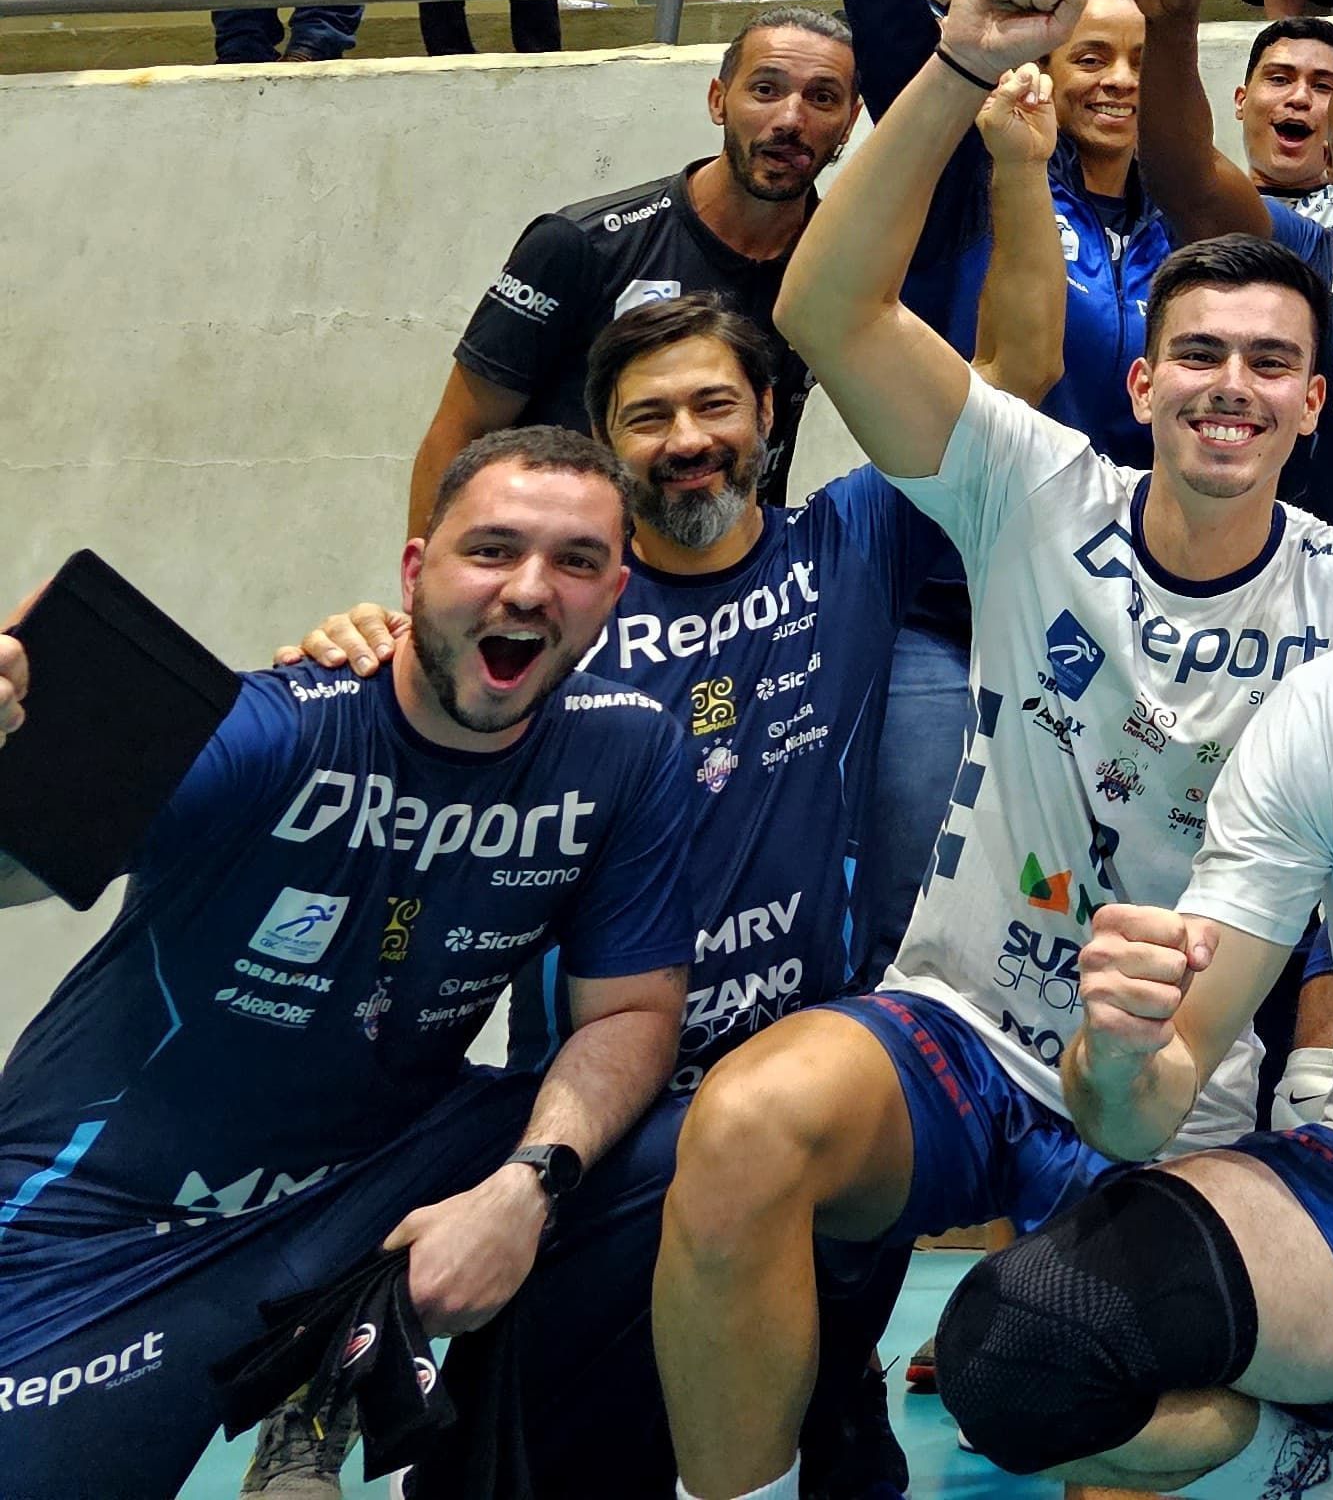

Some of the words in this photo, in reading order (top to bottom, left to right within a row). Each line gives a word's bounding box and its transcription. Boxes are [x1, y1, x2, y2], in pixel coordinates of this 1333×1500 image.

[618, 560, 819, 668] Report
[778, 652, 821, 692] Sicdi
[785, 723, 828, 751] Nicholas
[348, 773, 596, 872] Report
[490, 866, 581, 888] suzano
[694, 891, 802, 964] MRV
[1003, 918, 1081, 980] SUZ
[230, 989, 316, 1025] ÁRBORE
[234, 959, 335, 994] OBRAMAX
[681, 957, 803, 1027] ZANO
[993, 953, 1084, 1015] SHOP
[679, 989, 801, 1053] OPPING
[0, 1331, 165, 1414] Report
[105, 1358, 162, 1391] suzano
